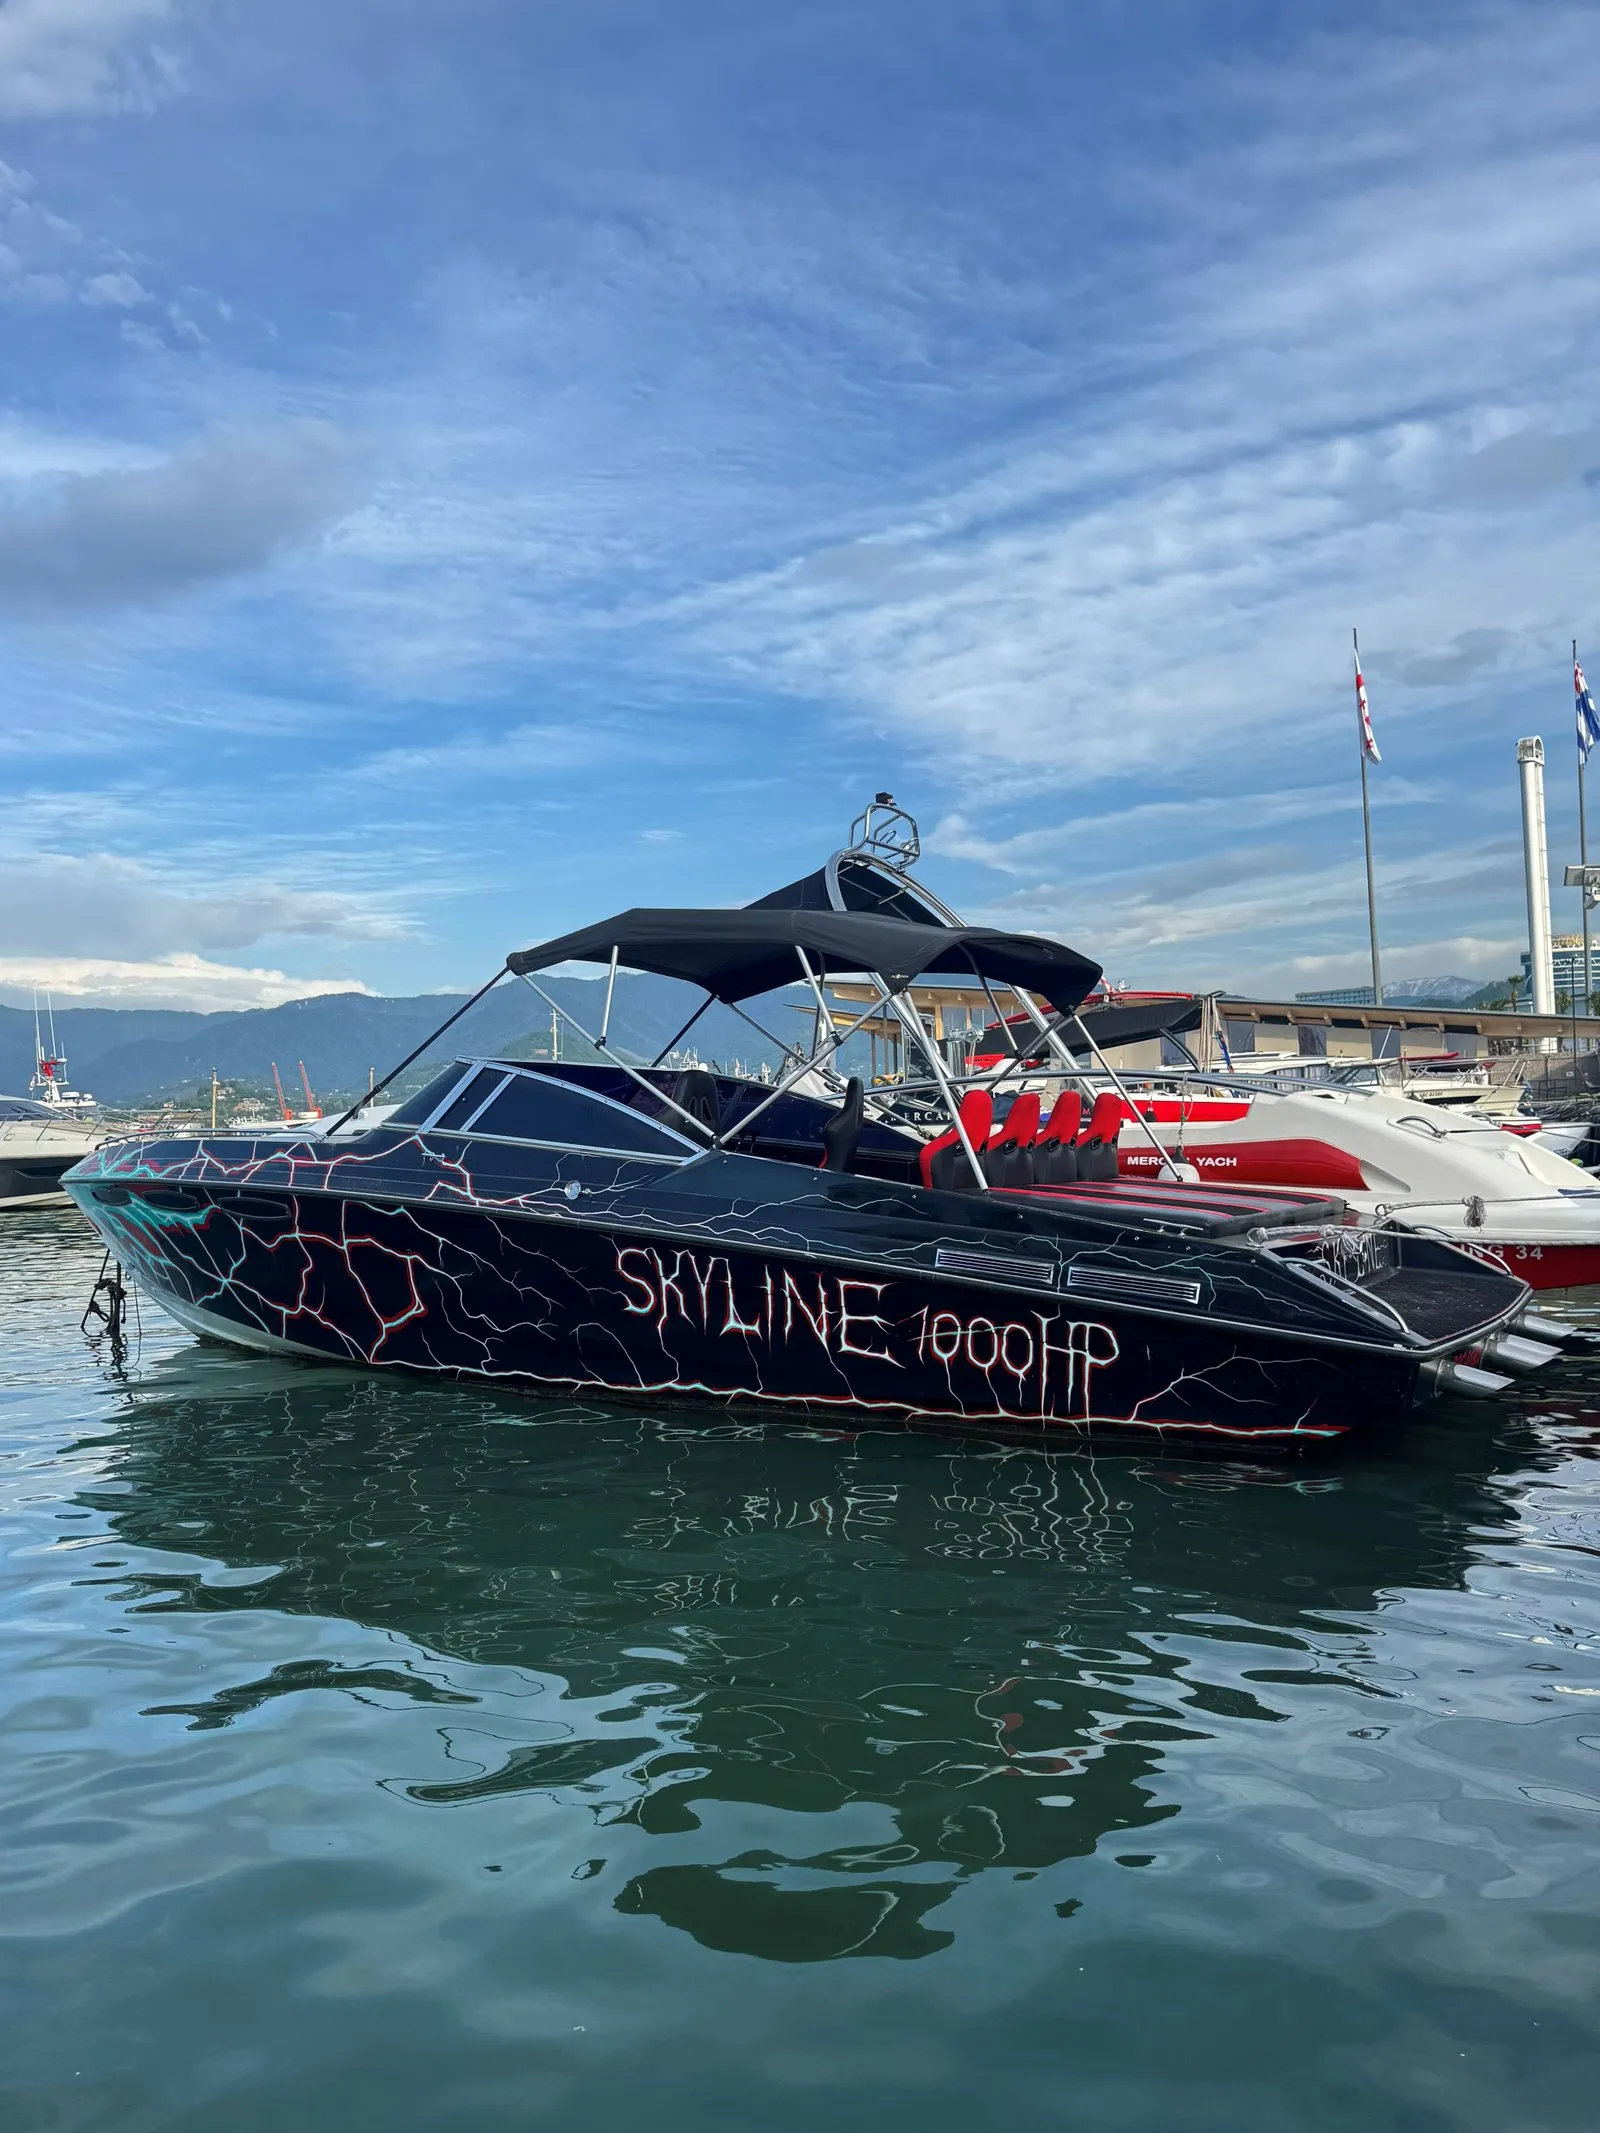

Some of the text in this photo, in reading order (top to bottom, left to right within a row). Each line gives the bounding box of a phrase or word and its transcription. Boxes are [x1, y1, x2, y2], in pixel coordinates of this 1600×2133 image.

[1196, 1156, 1238, 1167] YACH
[1515, 1245, 1544, 1260] 34
[615, 1245, 906, 1369] SKYLINE
